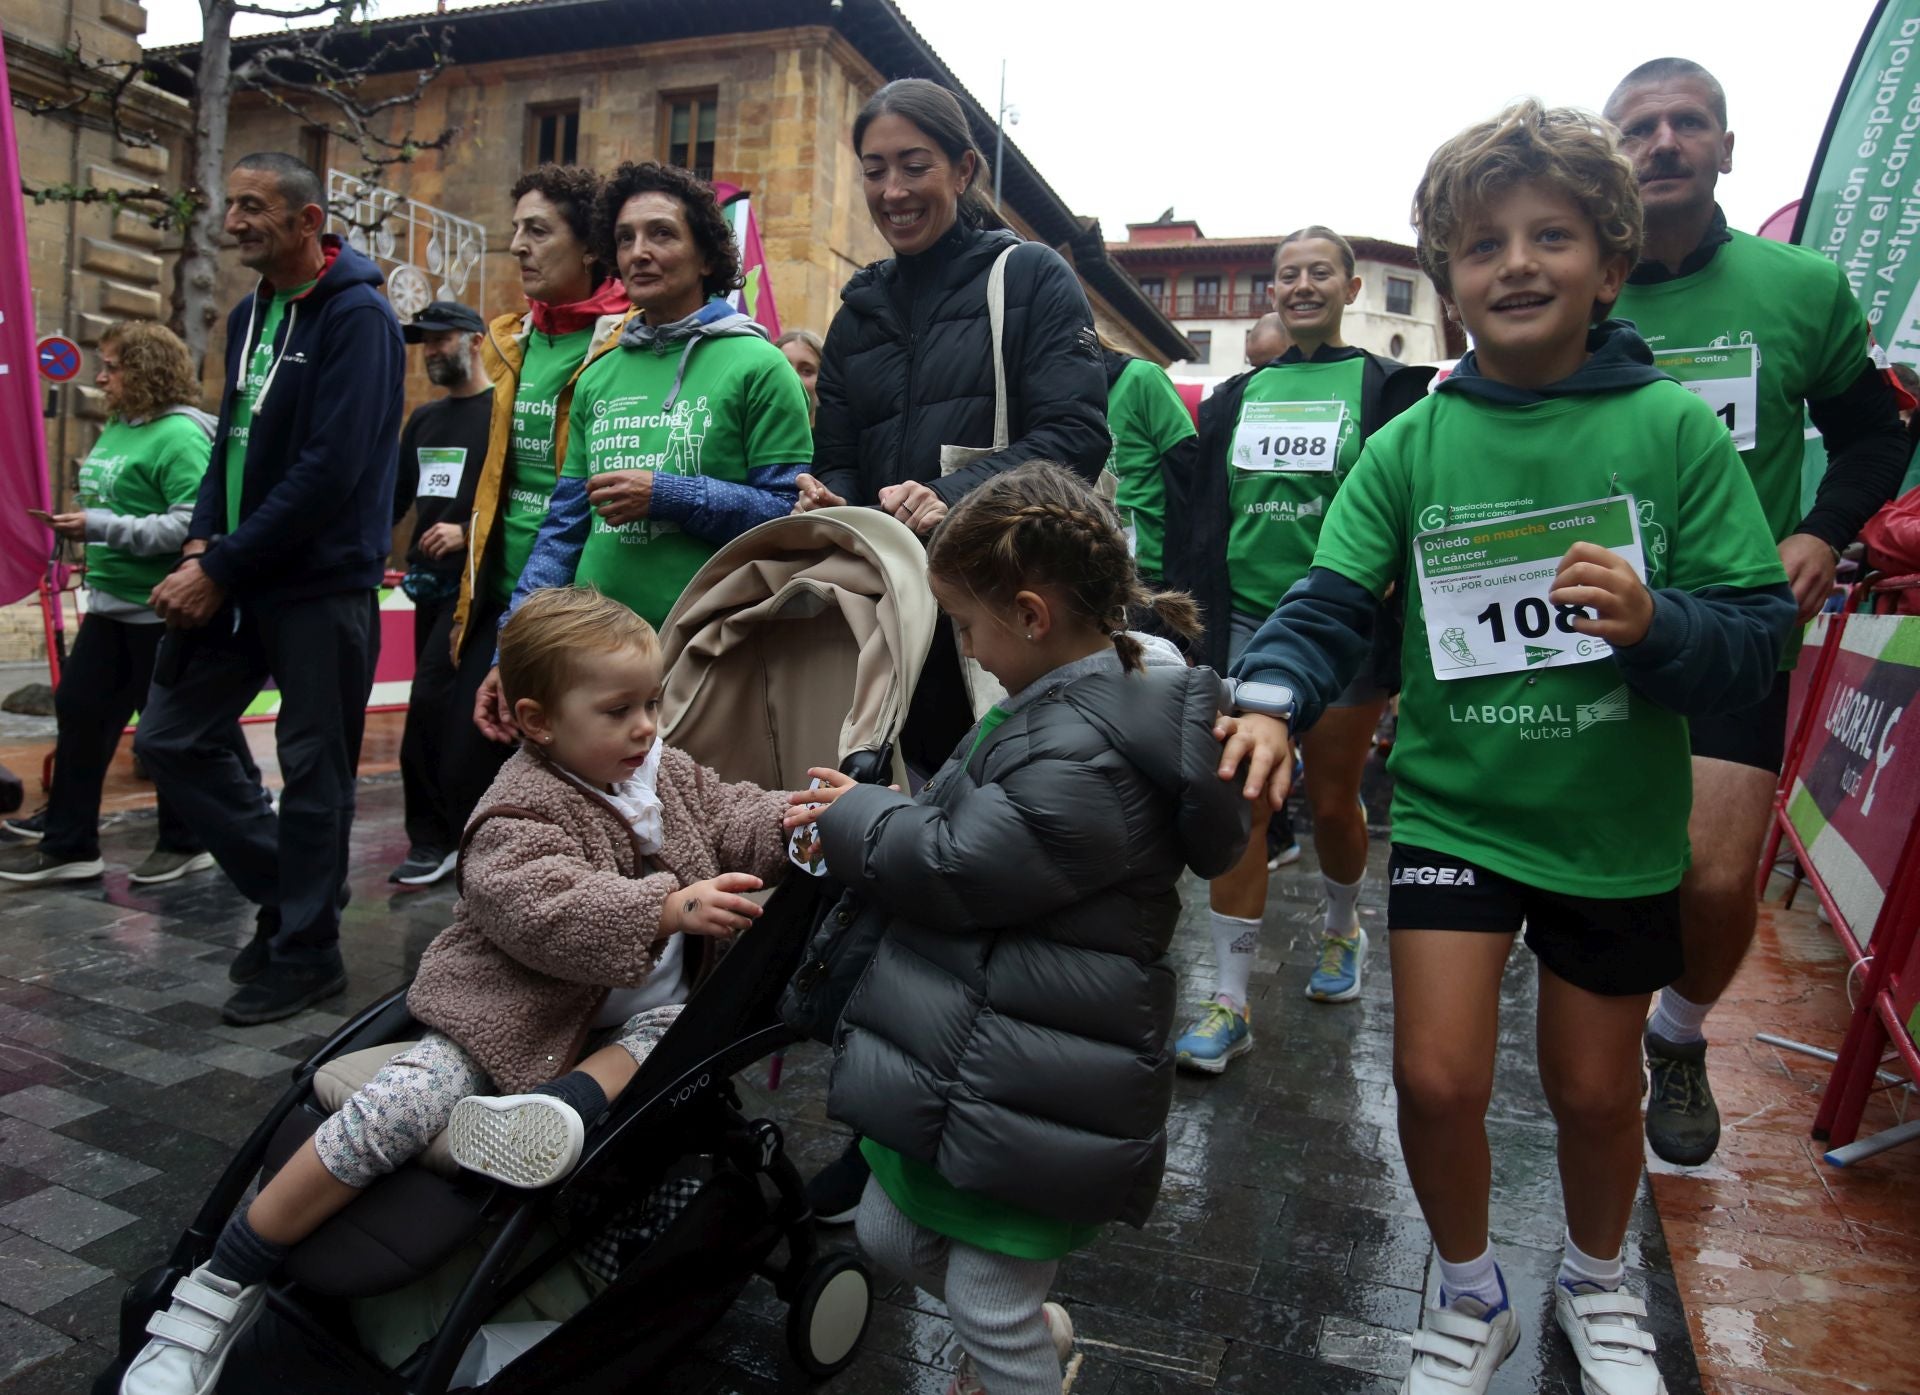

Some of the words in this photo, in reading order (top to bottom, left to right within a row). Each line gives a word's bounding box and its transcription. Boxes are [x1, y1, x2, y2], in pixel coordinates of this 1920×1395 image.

[1857, 18, 1920, 158] española
[1845, 229, 1881, 298] ntra
[1867, 195, 1892, 222] el
[1867, 289, 1890, 325] en
[1694, 354, 1728, 364] contra
[592, 418, 609, 436] En
[613, 411, 682, 430] marcha
[513, 437, 546, 453] ncer
[590, 432, 640, 454] contra
[1258, 436, 1328, 456] 1088
[590, 454, 600, 474] el
[603, 451, 664, 470] cáncer
[428, 473, 450, 488] 599
[511, 489, 543, 506] BORAL
[1244, 501, 1295, 514] LABORAL
[1494, 498, 1534, 509] española
[1270, 512, 1296, 522] kutxa
[1450, 511, 1476, 521] contra
[1486, 509, 1517, 518] cáncer
[620, 534, 648, 545] kutxa
[1424, 536, 1471, 552] Oviedo
[1473, 533, 1491, 545] en
[1493, 522, 1547, 541] marcha
[1548, 513, 1596, 531] contra
[1427, 555, 1440, 567] el
[1442, 550, 1487, 563] cáncer
[1462, 562, 1486, 570] CONTRA
[1431, 586, 1439, 595] Y
[1440, 583, 1454, 593] TÚ
[1456, 580, 1482, 593] ¿POR
[1484, 574, 1517, 587] QUIÉN
[1449, 704, 1571, 724] LABORAL
[1824, 681, 1885, 760] LABORAL
[1520, 726, 1572, 741] kutxa
[1391, 866, 1476, 886] LEGEA
[668, 1073, 710, 1108] YOYO
